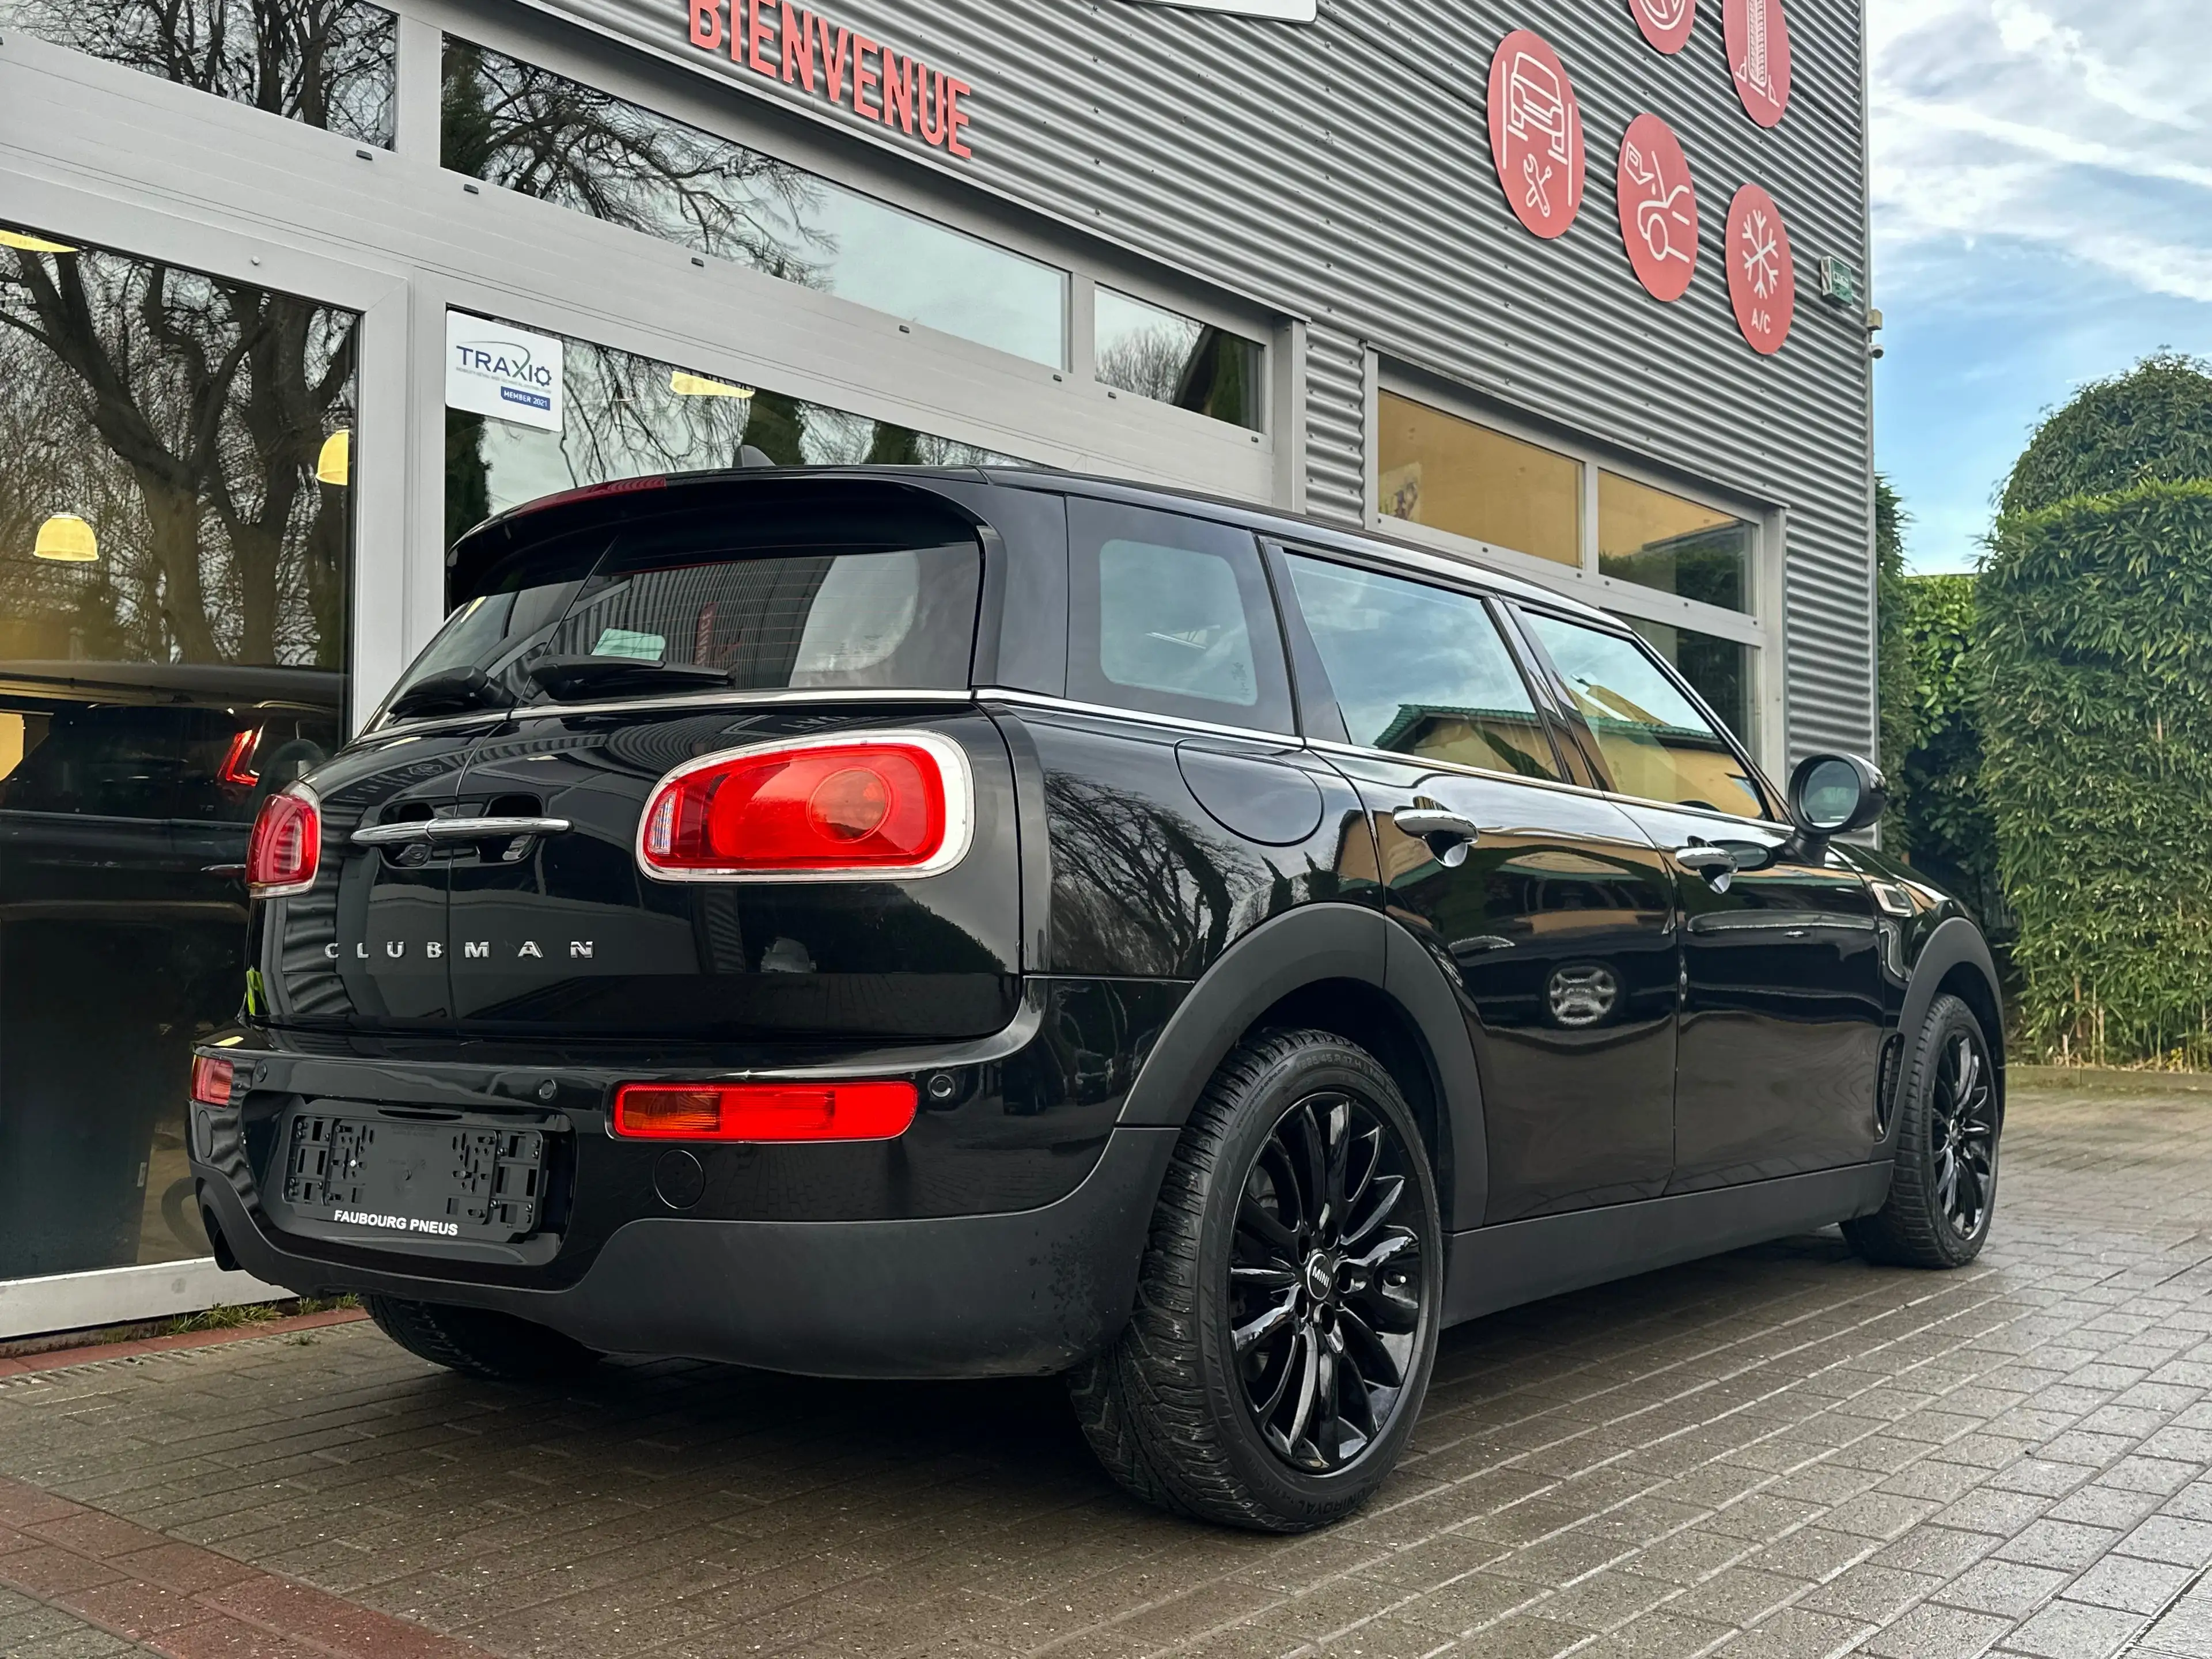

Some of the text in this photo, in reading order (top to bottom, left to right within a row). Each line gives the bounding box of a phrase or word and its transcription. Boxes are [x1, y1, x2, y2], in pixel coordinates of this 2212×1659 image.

[690, 0, 972, 160] BIENVENUE
[1751, 308, 1771, 334] A/C
[456, 342, 552, 387] TRAXIO
[504, 389, 547, 407] MEMBER 2021
[324, 940, 594, 959] CLUBMAN
[334, 1210, 459, 1236] FAUBOURG PNEUS
[1312, 1266, 1330, 1287] MINI
[1301, 1486, 1366, 1516] UNIROYAL
